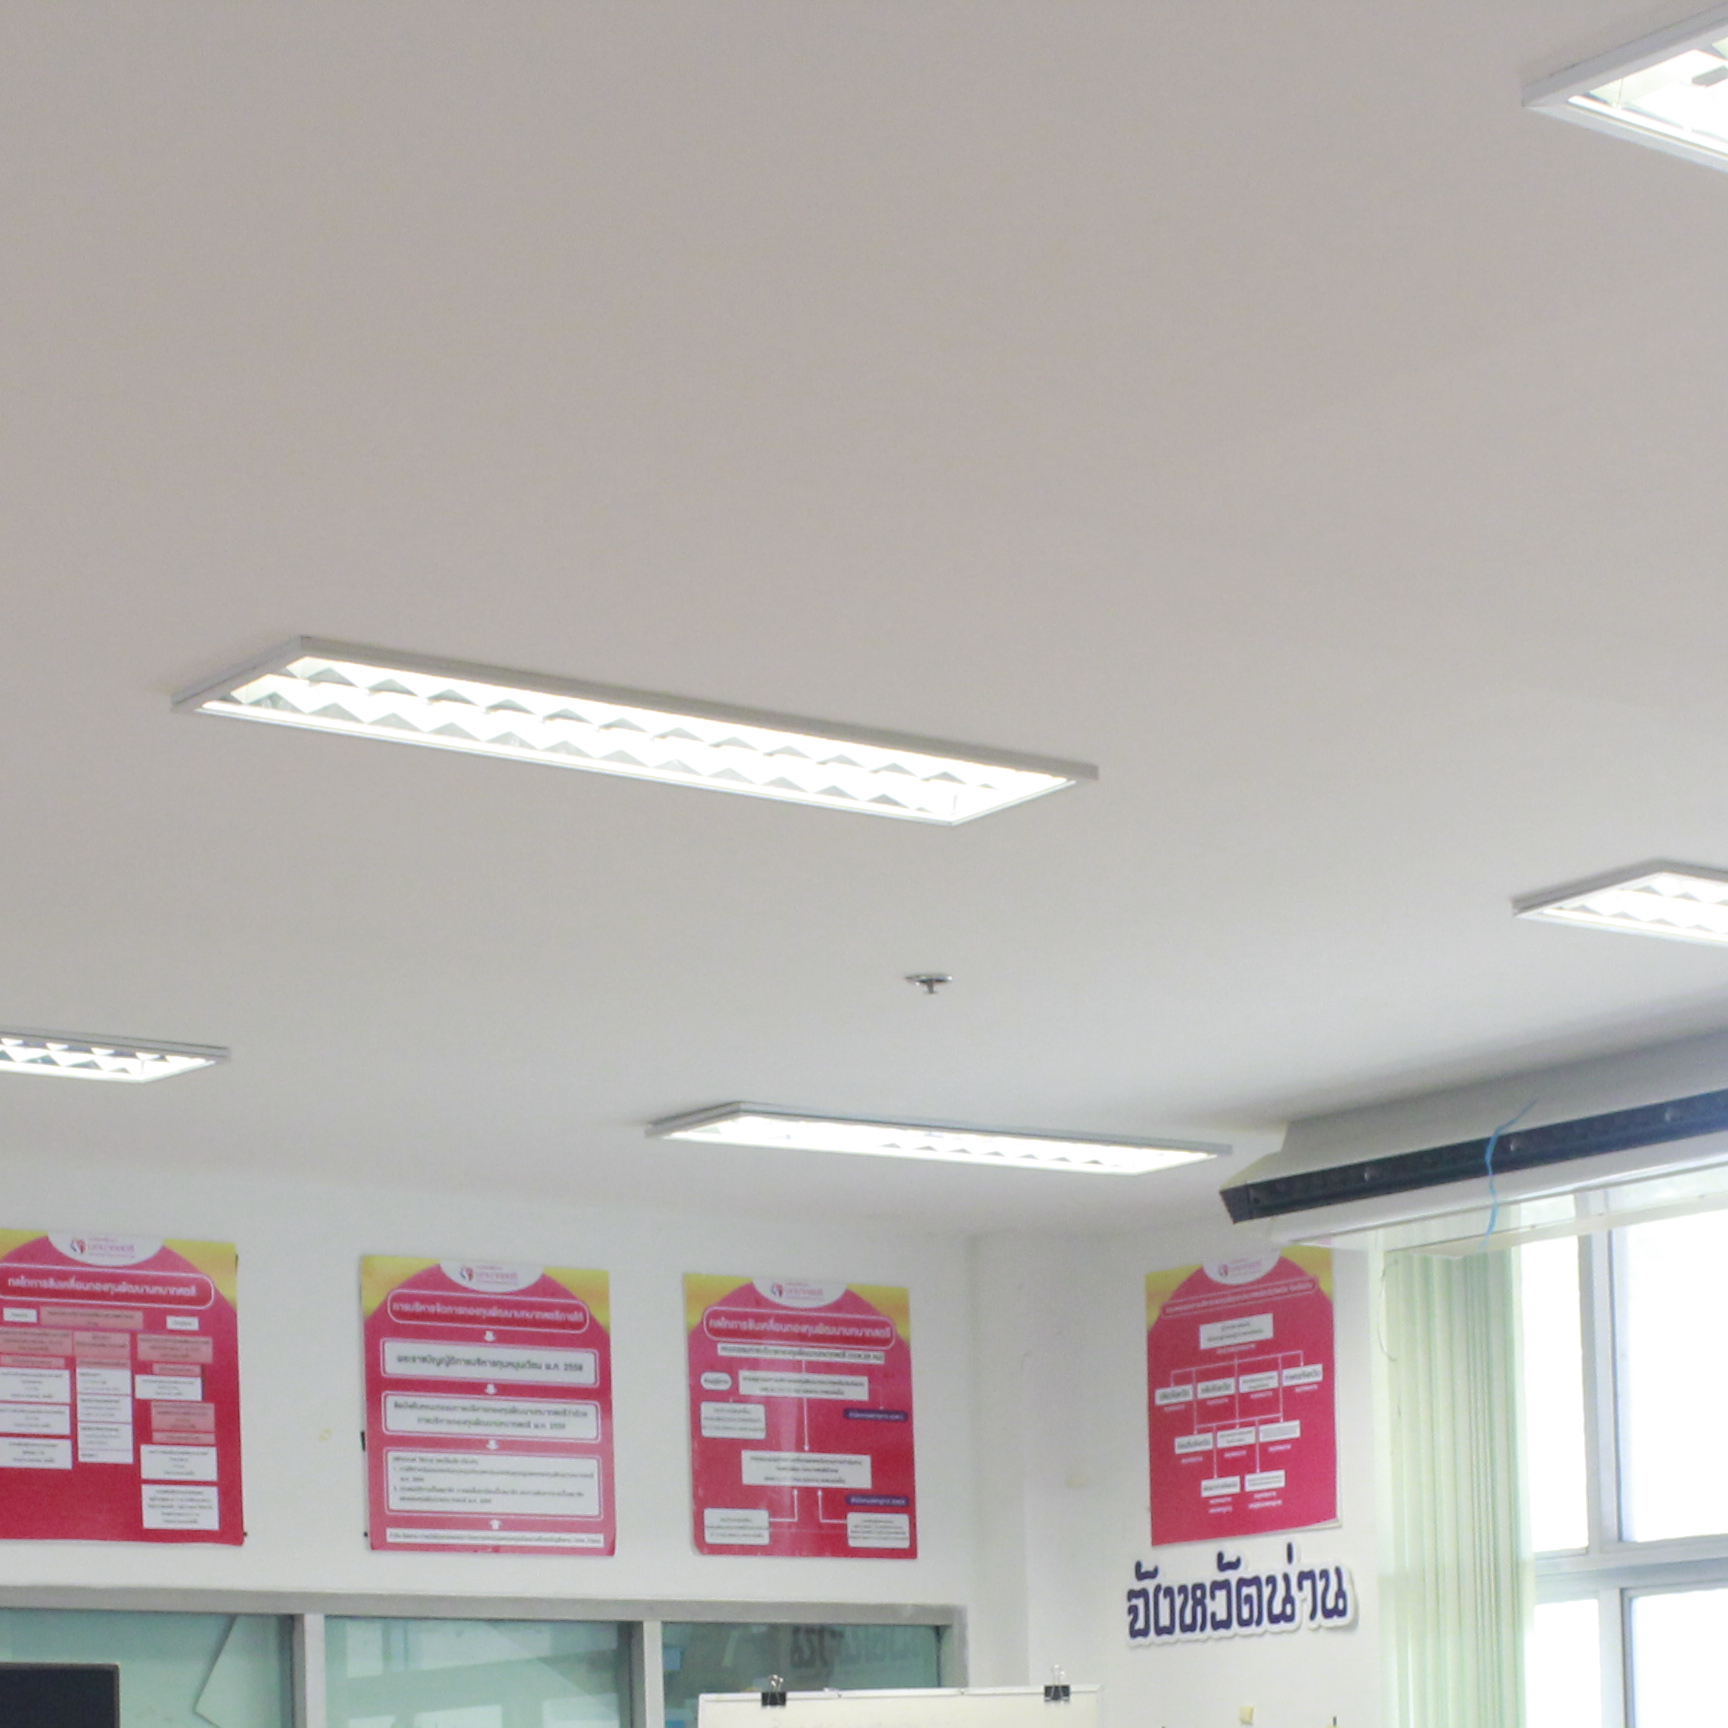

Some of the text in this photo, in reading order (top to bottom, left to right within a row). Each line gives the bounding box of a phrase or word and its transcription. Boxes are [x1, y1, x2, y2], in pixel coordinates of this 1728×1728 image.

[1127, 1542, 1349, 1640] จังหวัดน่าน
